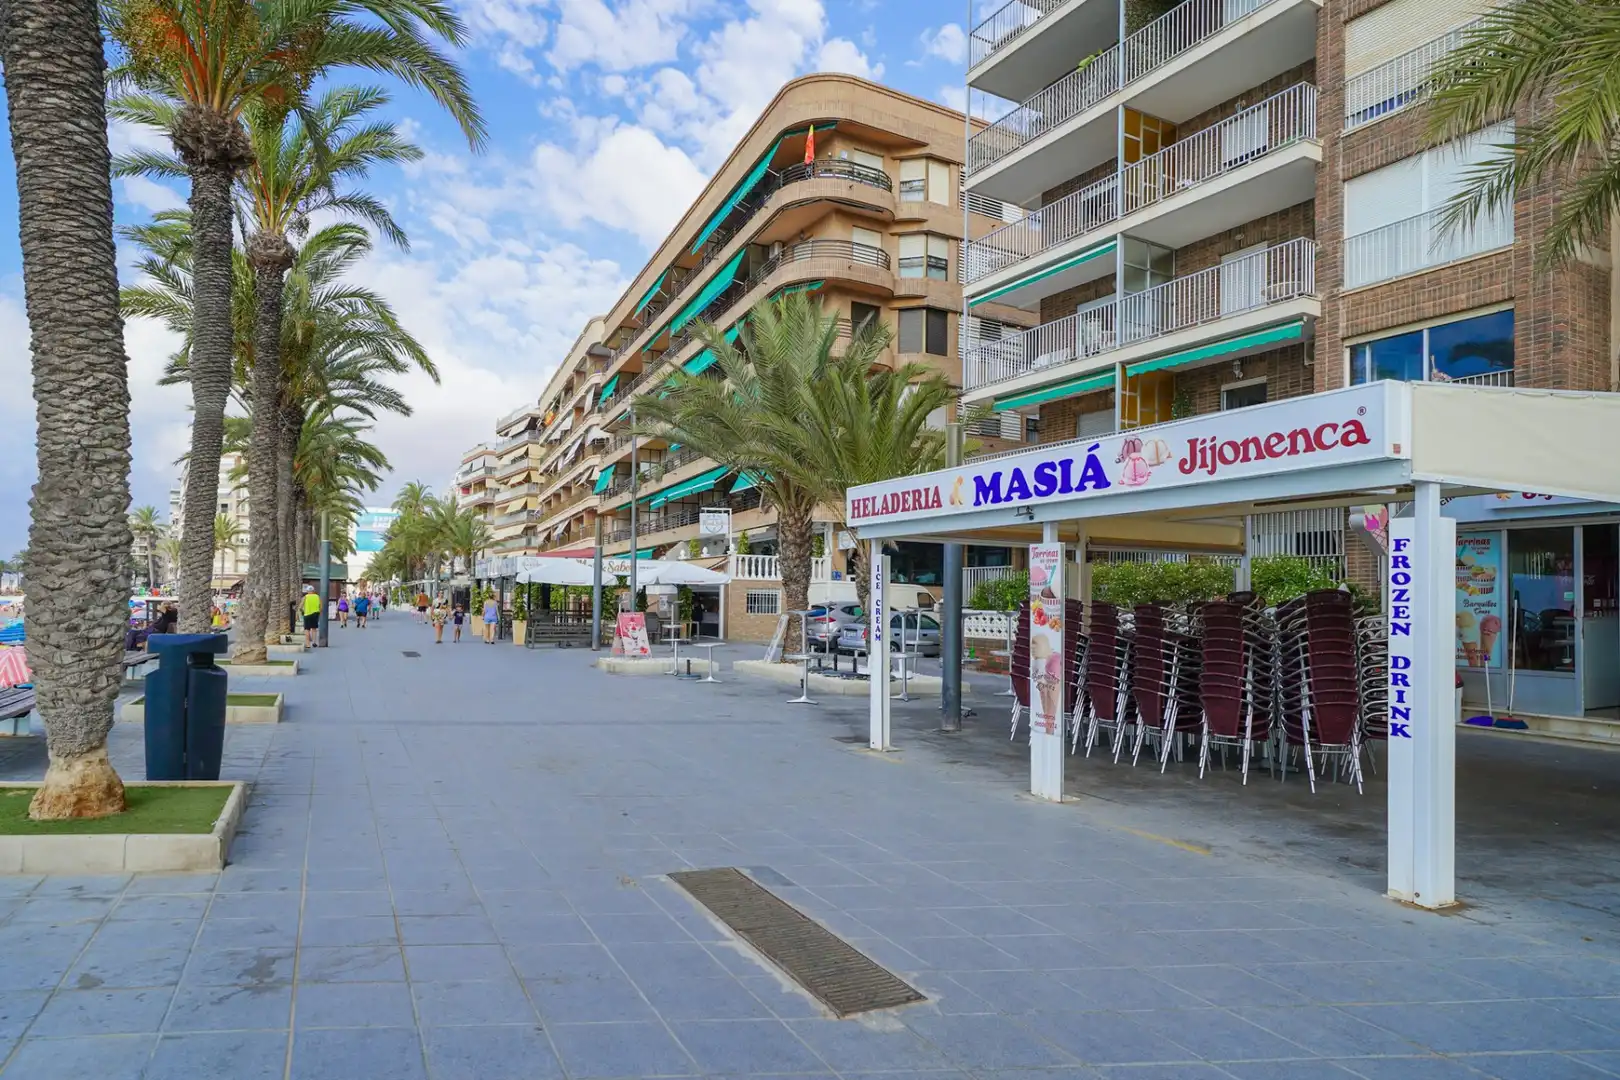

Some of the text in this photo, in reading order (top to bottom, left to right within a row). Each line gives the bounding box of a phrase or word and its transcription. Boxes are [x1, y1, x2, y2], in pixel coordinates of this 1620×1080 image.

[851, 418, 1371, 519] HELADERIA MASIÁ Jijonenca
[1390, 538, 1412, 739] FROZEN DRINK
